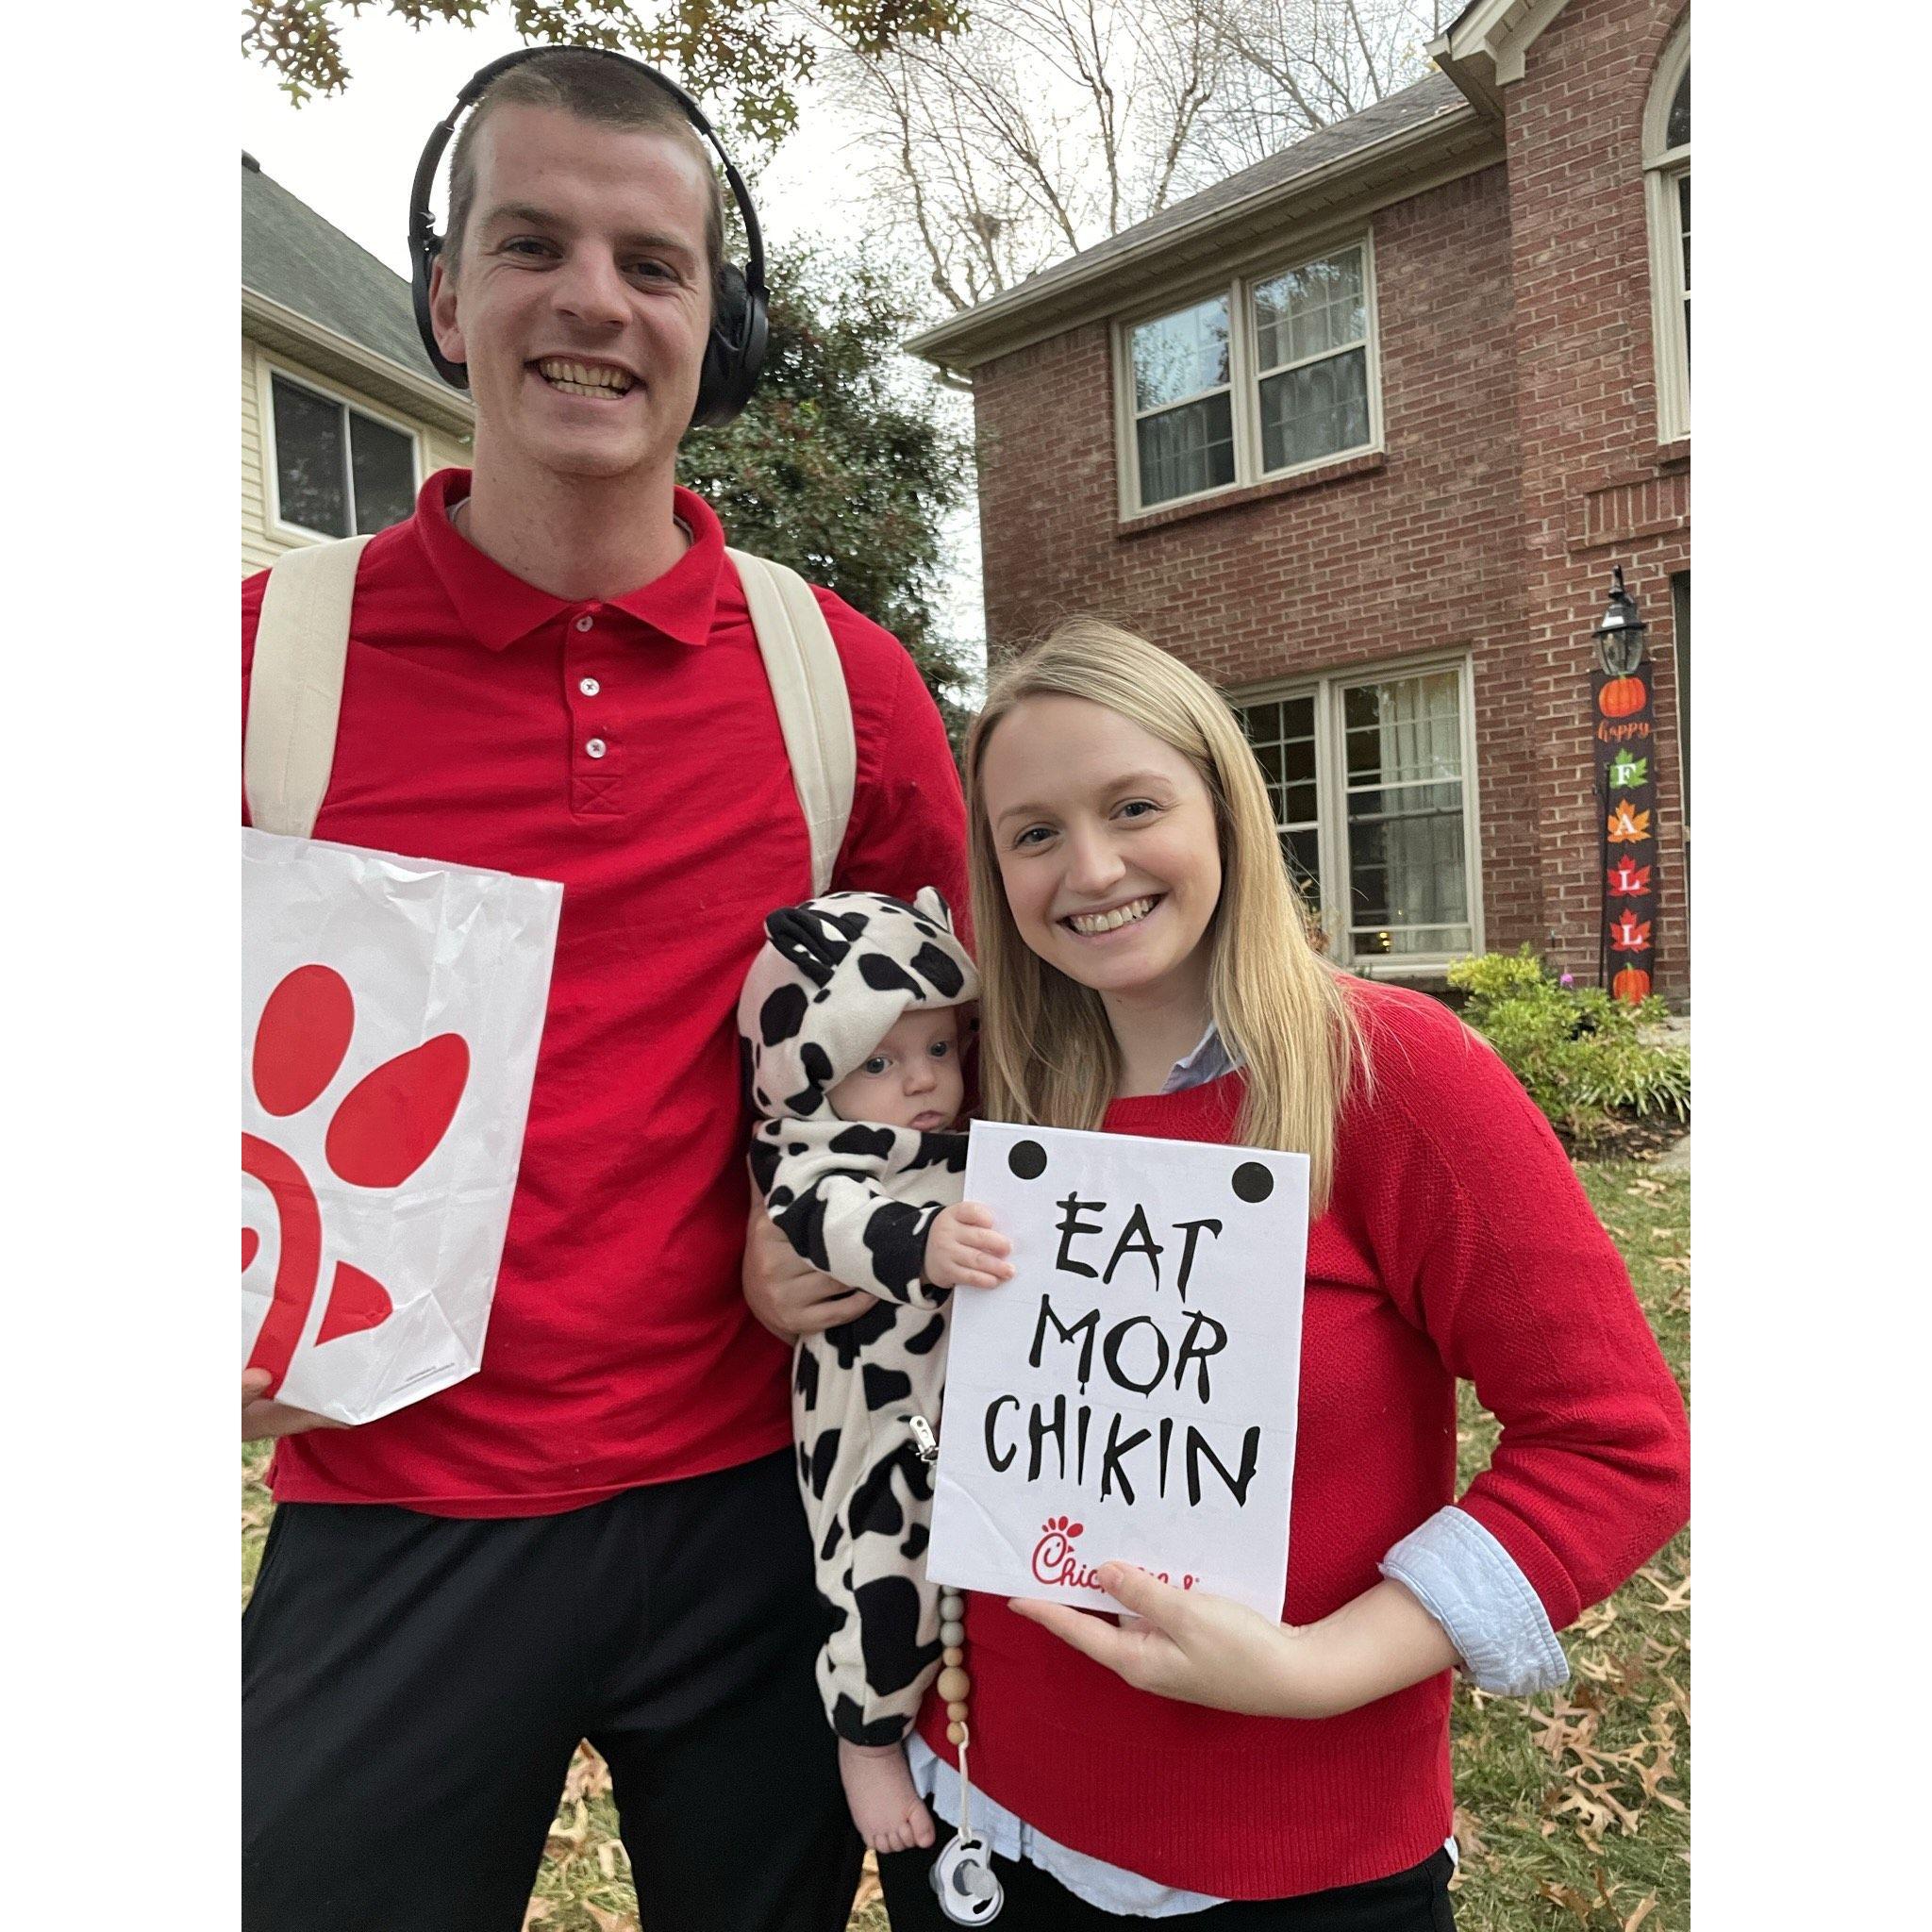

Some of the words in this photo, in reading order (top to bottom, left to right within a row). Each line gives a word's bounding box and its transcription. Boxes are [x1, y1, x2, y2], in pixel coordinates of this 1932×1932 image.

[1598, 720, 1650, 742] happy
[1613, 762, 1644, 945] FALL
[1056, 1191, 1223, 1304] EAT
[1029, 1293, 1228, 1405] MOR
[984, 1393, 1261, 1508] CHIKIN
